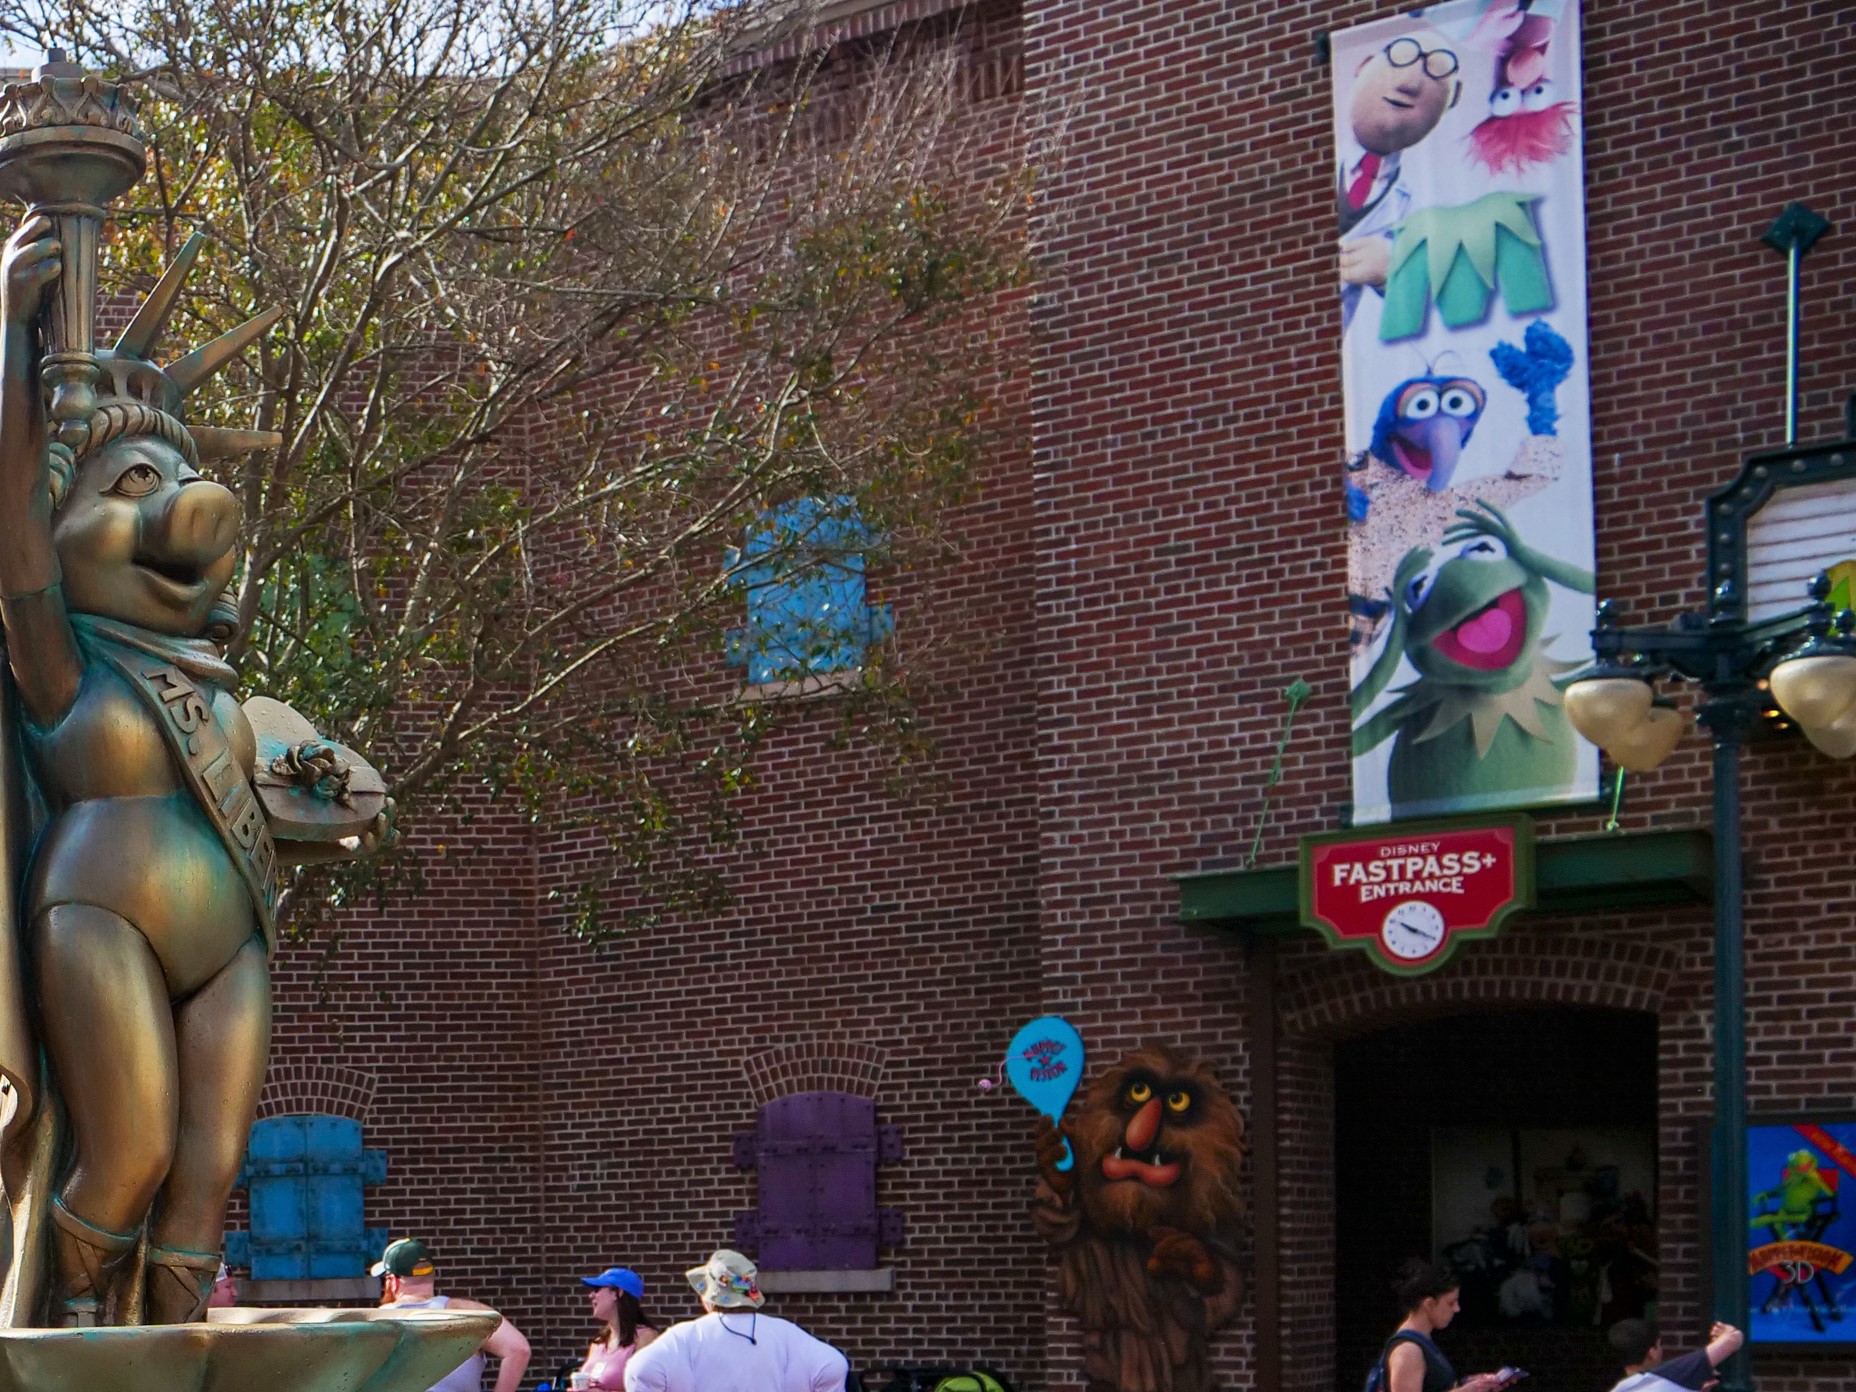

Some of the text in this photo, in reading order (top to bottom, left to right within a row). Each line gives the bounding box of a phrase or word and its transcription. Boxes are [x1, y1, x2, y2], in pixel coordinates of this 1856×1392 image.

[142, 667, 210, 756] MS.
[1380, 841, 1441, 858] DISNEY
[1332, 850, 1497, 887] FASTPASS+
[1359, 876, 1465, 904] ENTRANCE
[1781, 1260, 1815, 1285] 3D
